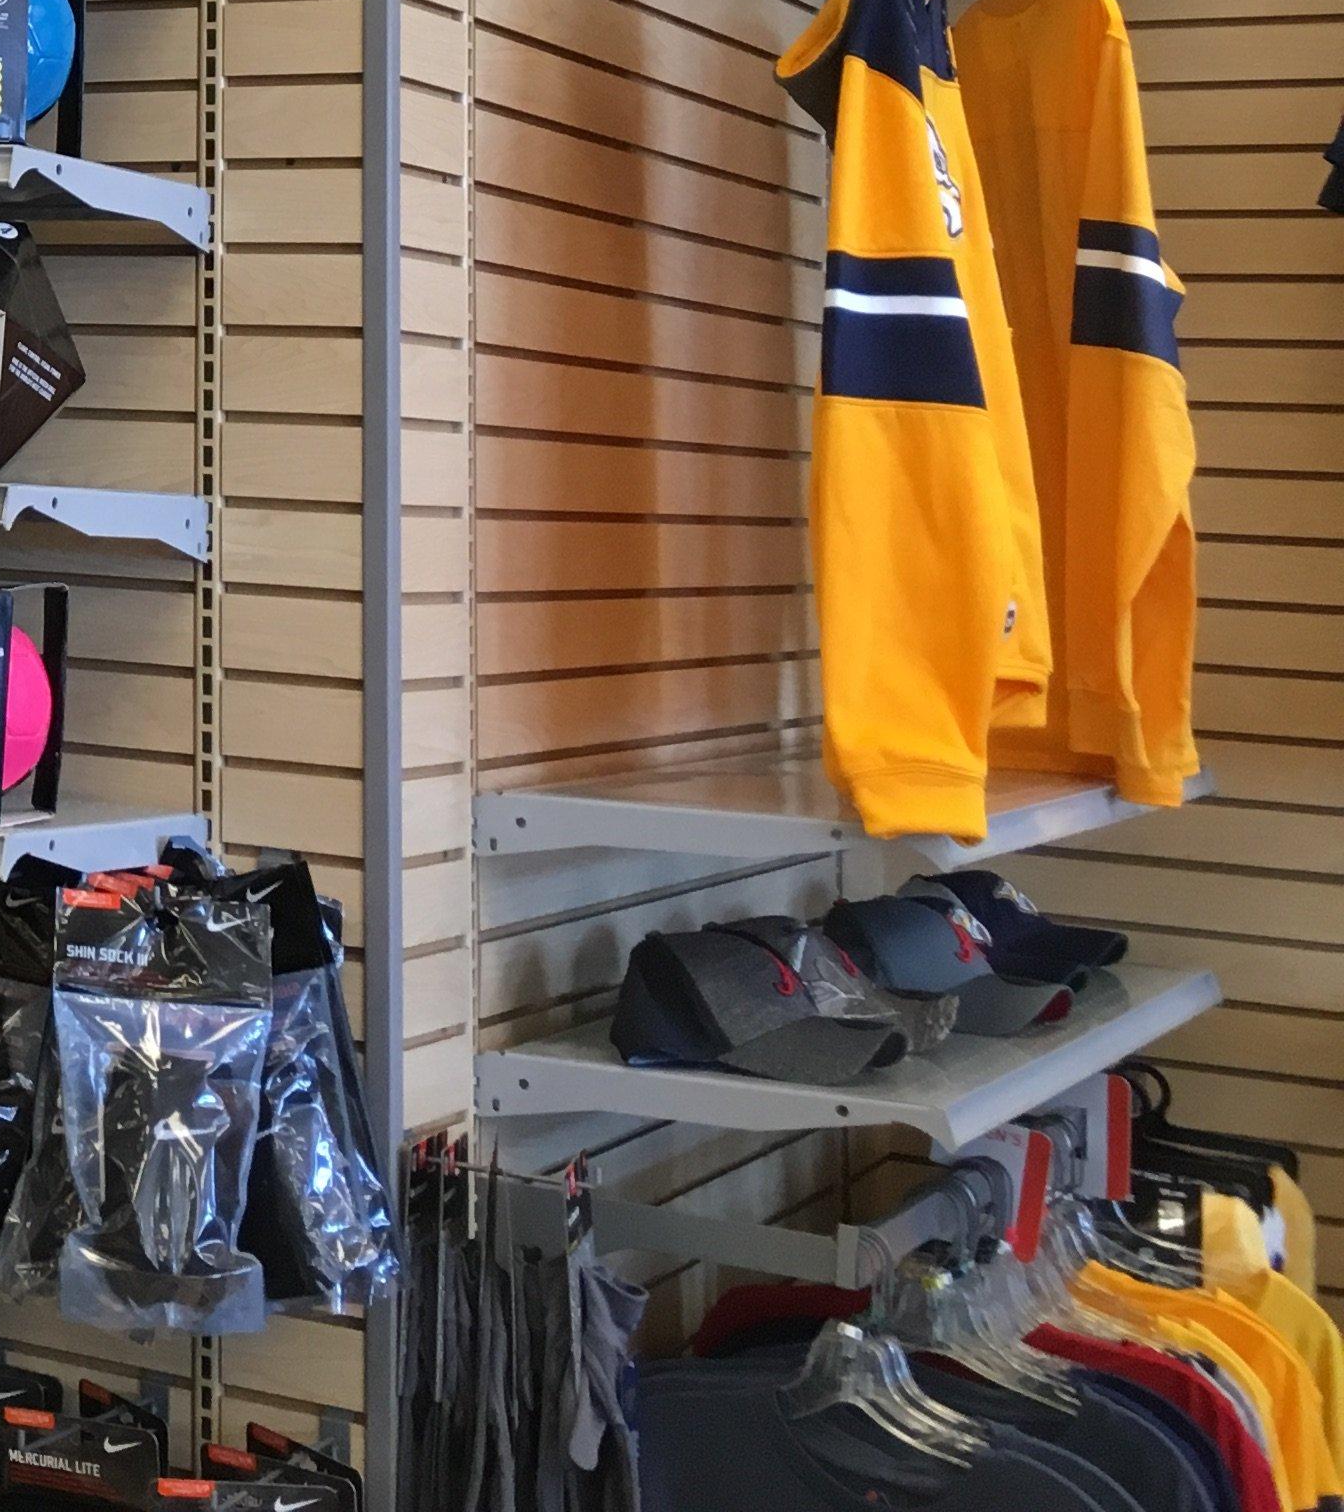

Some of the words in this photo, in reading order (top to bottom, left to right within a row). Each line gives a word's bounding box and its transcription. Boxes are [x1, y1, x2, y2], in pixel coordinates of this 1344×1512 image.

[66, 944, 96, 960] SHIN
[99, 949, 133, 966] SOCK
[9, 1449, 73, 1472] MERCURIAL
[75, 1461, 101, 1478] LITE
